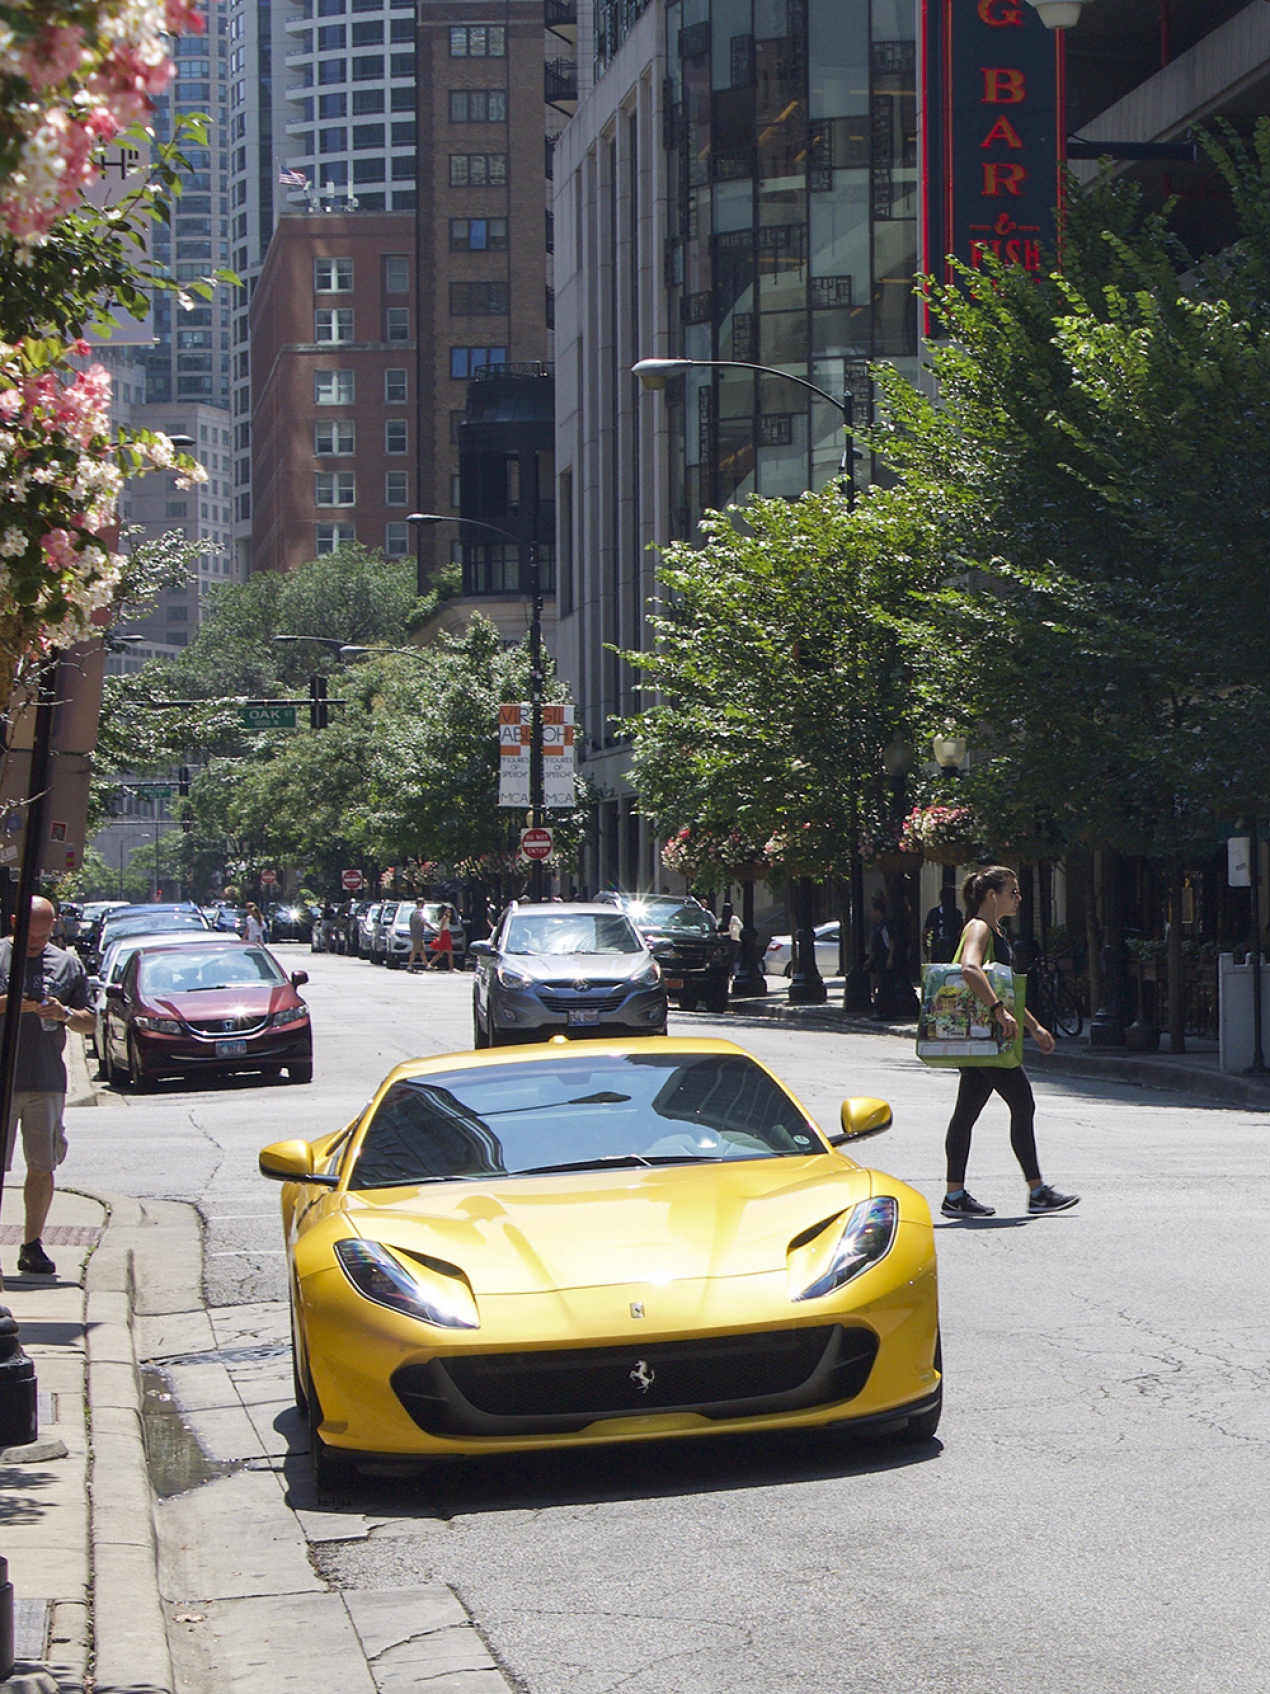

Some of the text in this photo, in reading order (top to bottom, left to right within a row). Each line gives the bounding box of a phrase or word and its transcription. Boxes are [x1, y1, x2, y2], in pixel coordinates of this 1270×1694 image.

[980, 67, 1026, 195] BAR
[993, 212, 1017, 236] &
[249, 710, 280, 719] OAK
[502, 793, 528, 804] MCA
[545, 793, 573, 804] MCA
